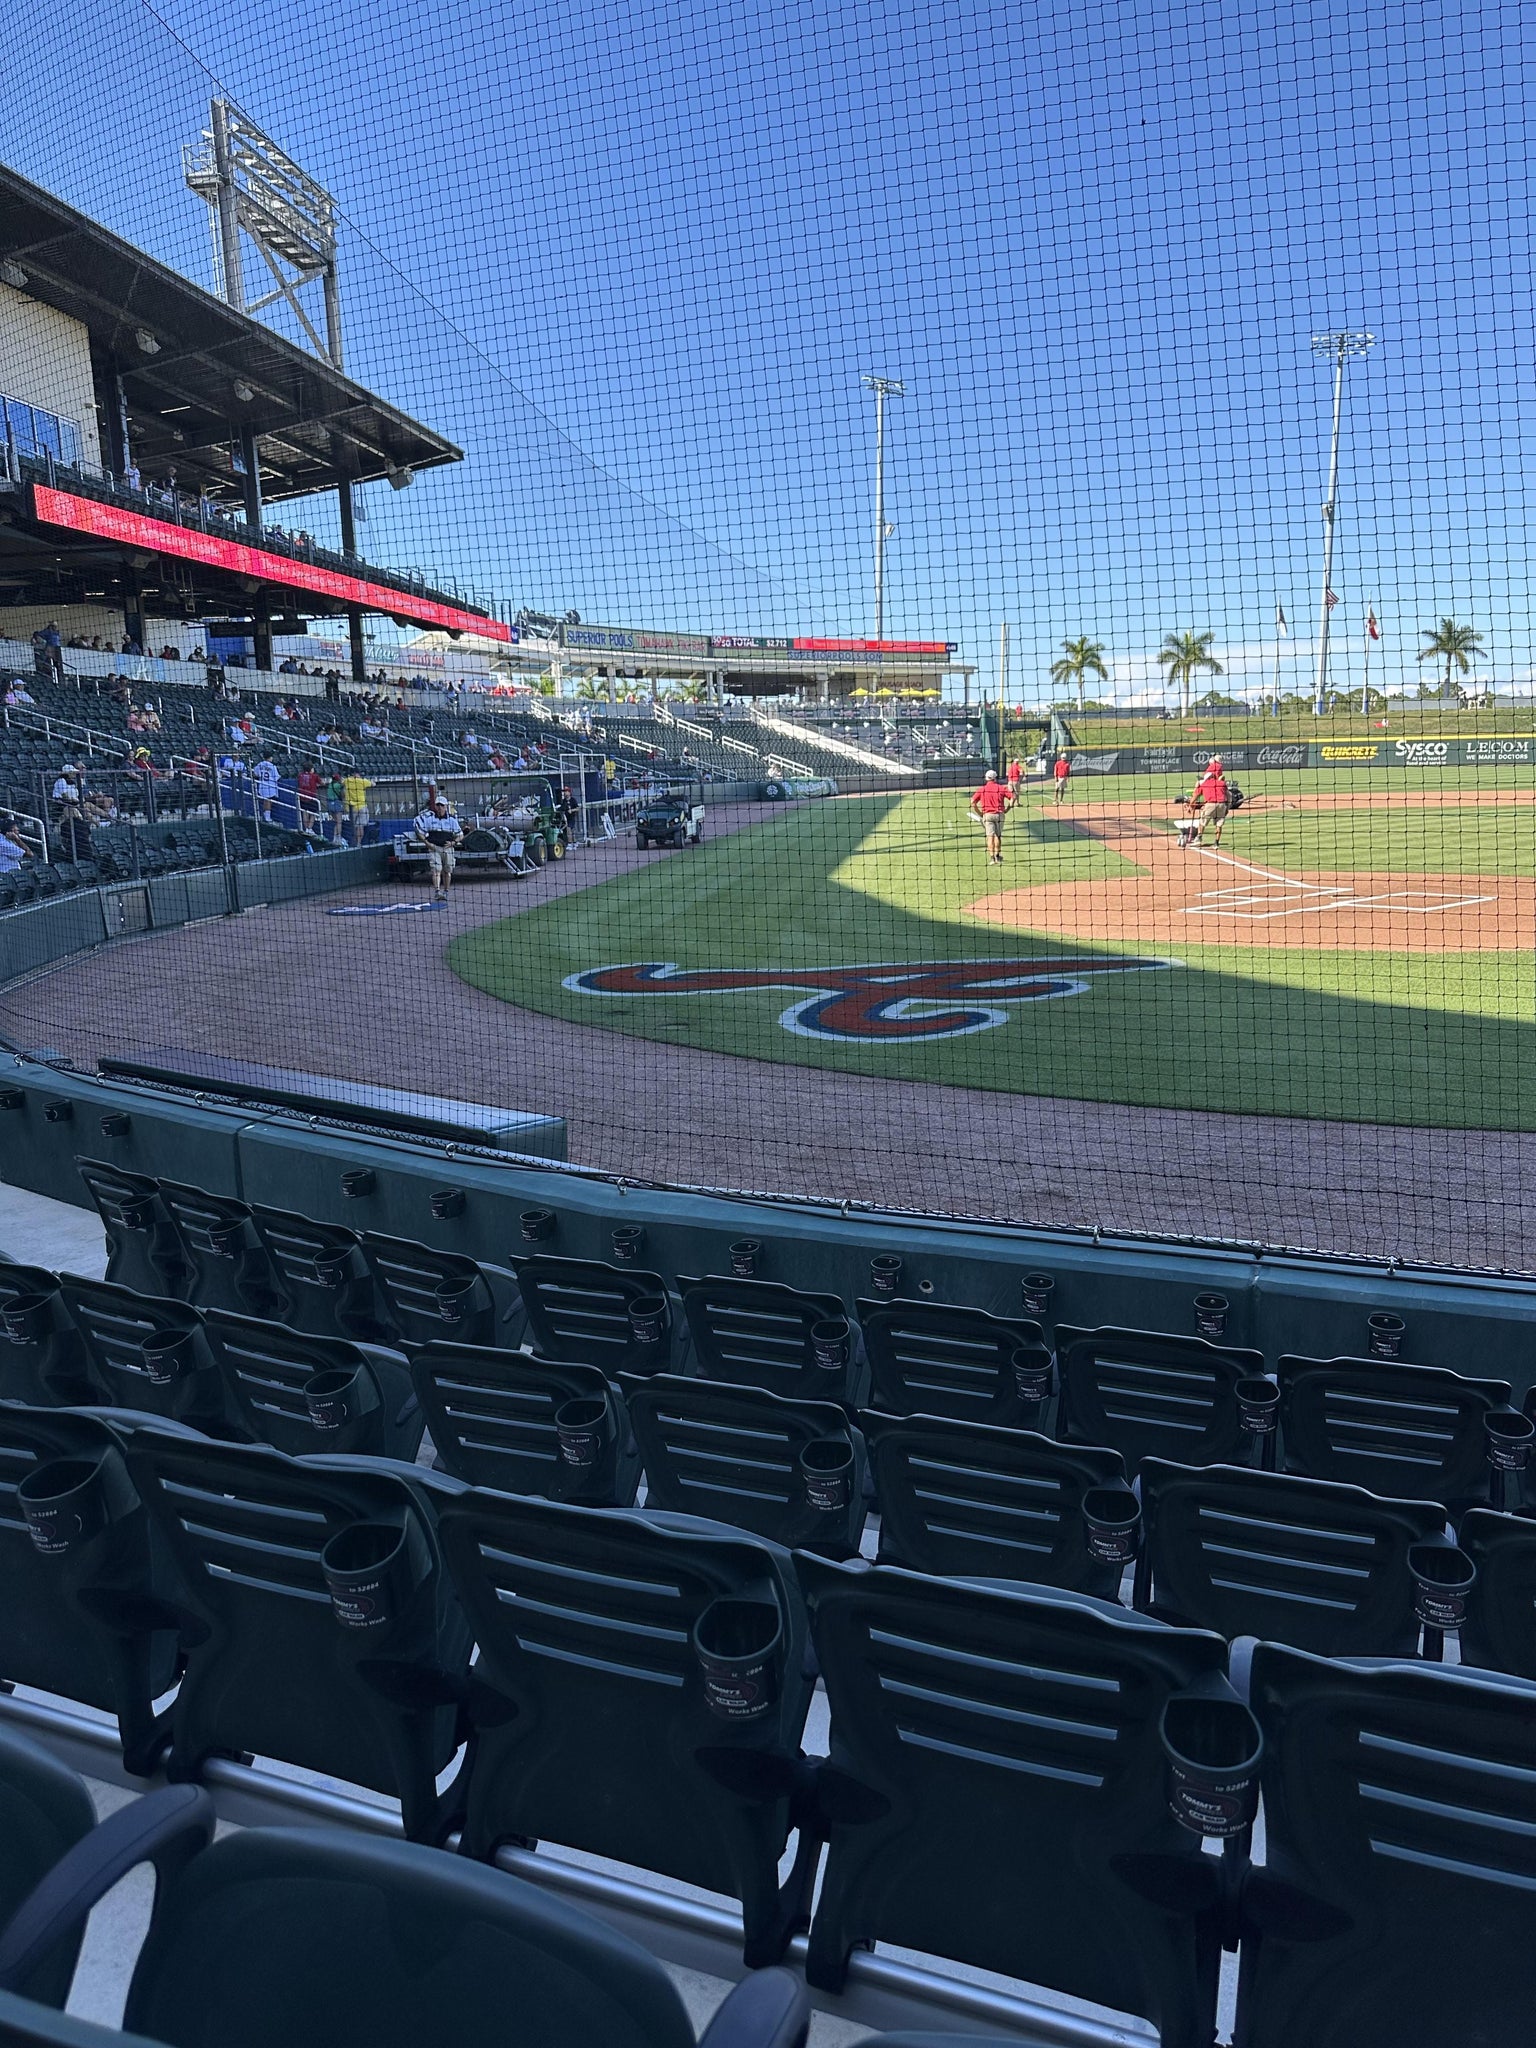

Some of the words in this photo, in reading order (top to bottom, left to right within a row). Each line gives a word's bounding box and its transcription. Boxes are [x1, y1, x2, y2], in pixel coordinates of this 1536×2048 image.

[567, 630, 606, 645] SUPERIOR
[609, 634, 633, 647] POOLS
[1210, 751, 1244, 760] TNDEM
[1321, 746, 1377, 757] QUIKRETE
[1395, 739, 1447, 760] Sysco
[1181, 1792, 1222, 1811] TOMMY'S
[1202, 1823, 1228, 1832] Works
[1229, 1820, 1248, 1832] Wash
